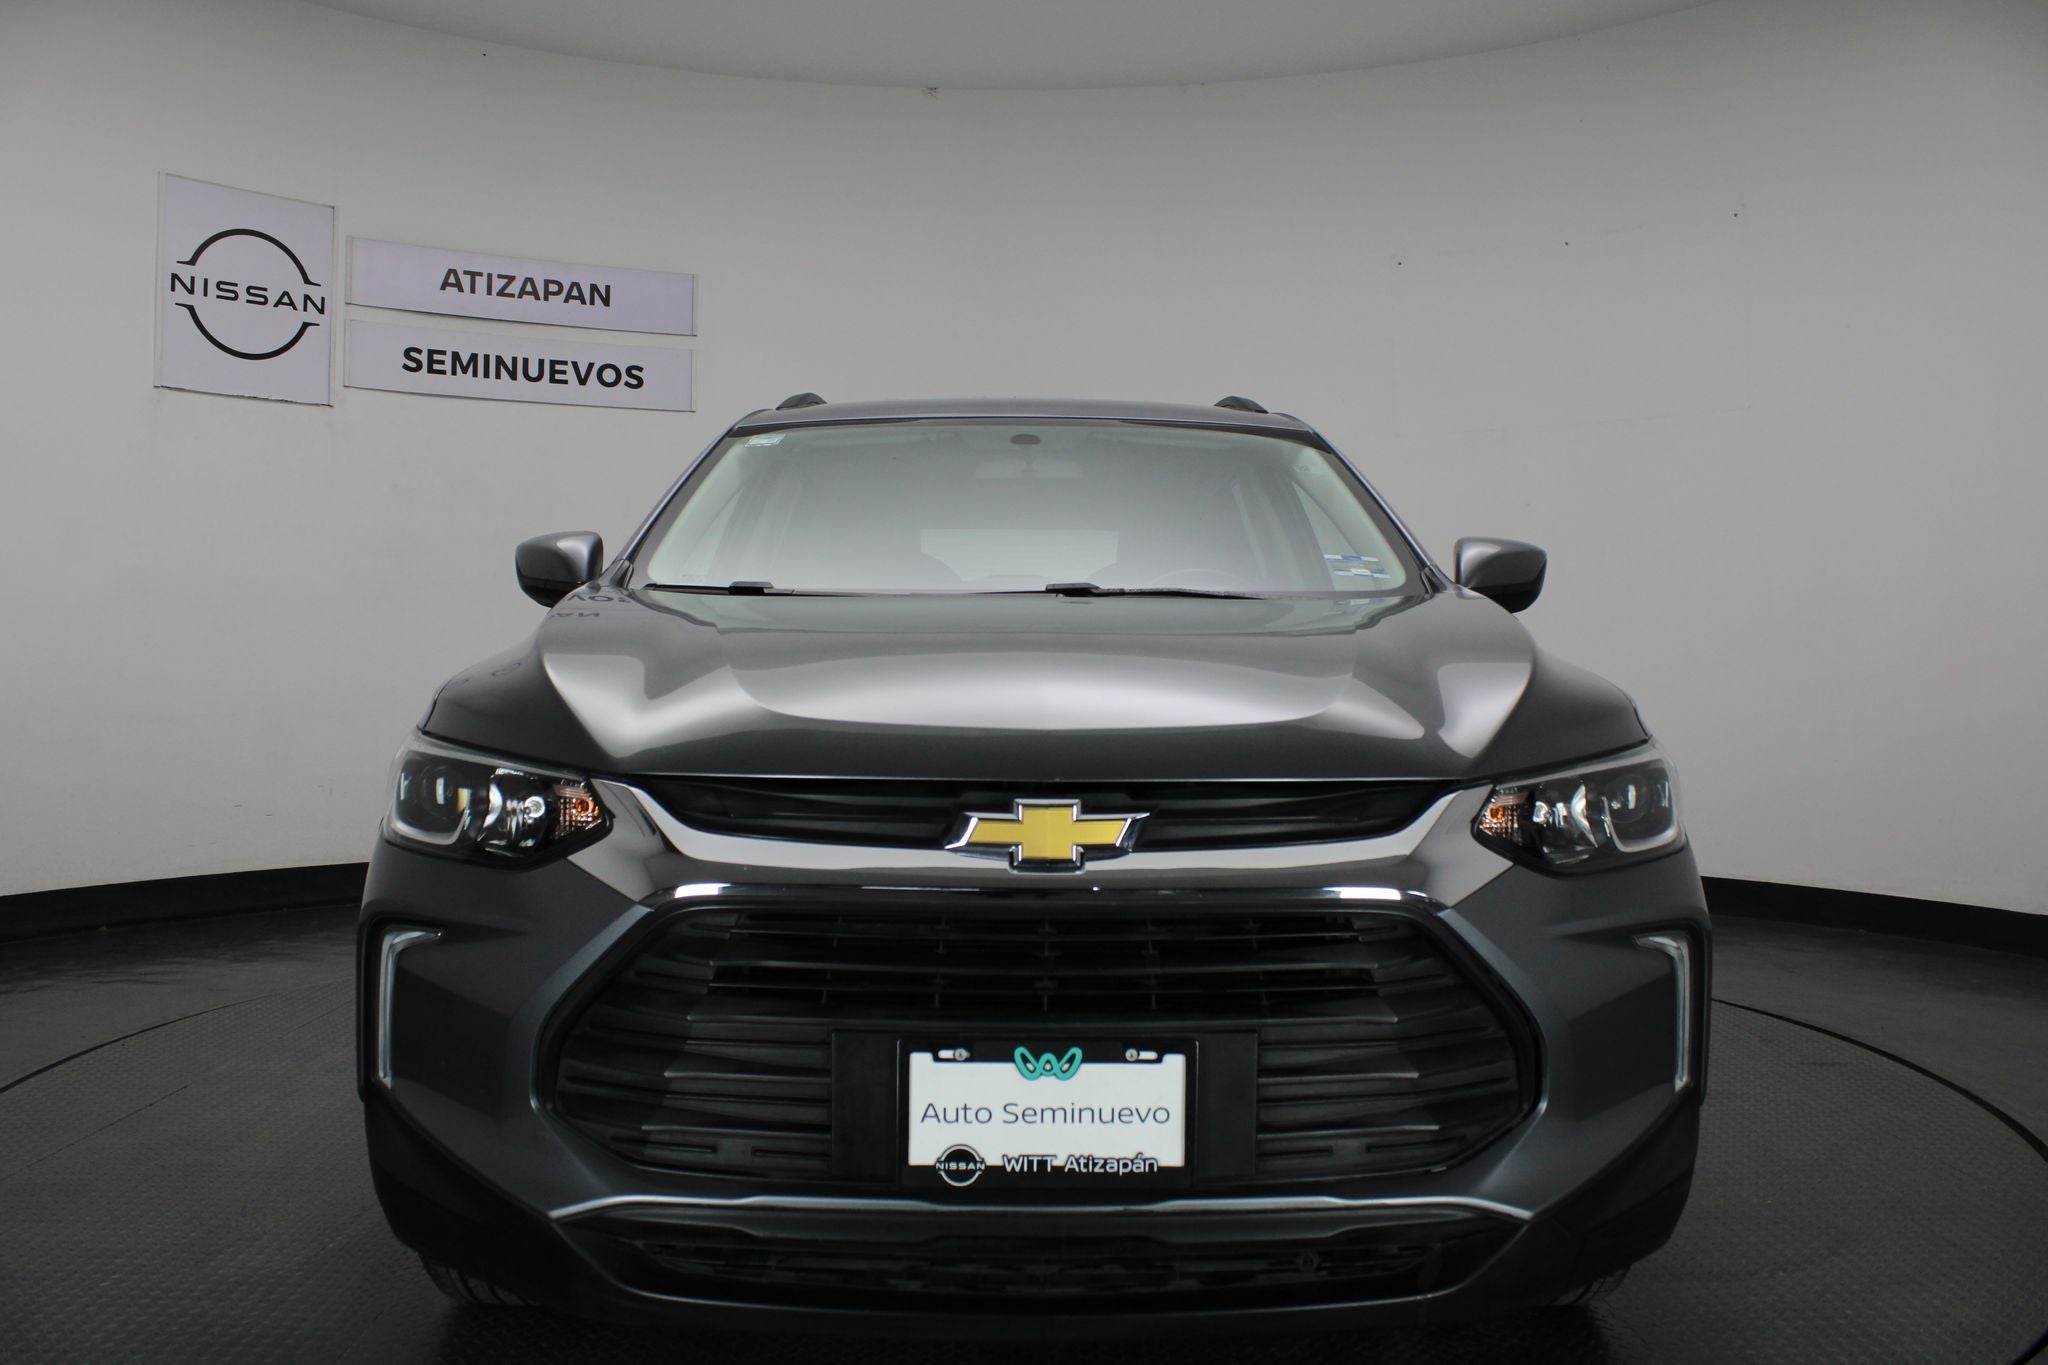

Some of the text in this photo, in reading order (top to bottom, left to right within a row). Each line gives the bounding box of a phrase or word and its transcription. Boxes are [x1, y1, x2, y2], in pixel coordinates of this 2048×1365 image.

[170, 272, 325, 315] NISSAN
[439, 268, 611, 307] ATIZAPAN
[402, 347, 645, 390] SEMINUEVOS
[921, 1102, 1170, 1124] Auto Seminuevo
[936, 1160, 985, 1171] NISSAN
[1003, 1153, 1158, 1176] WITT Atizapán
